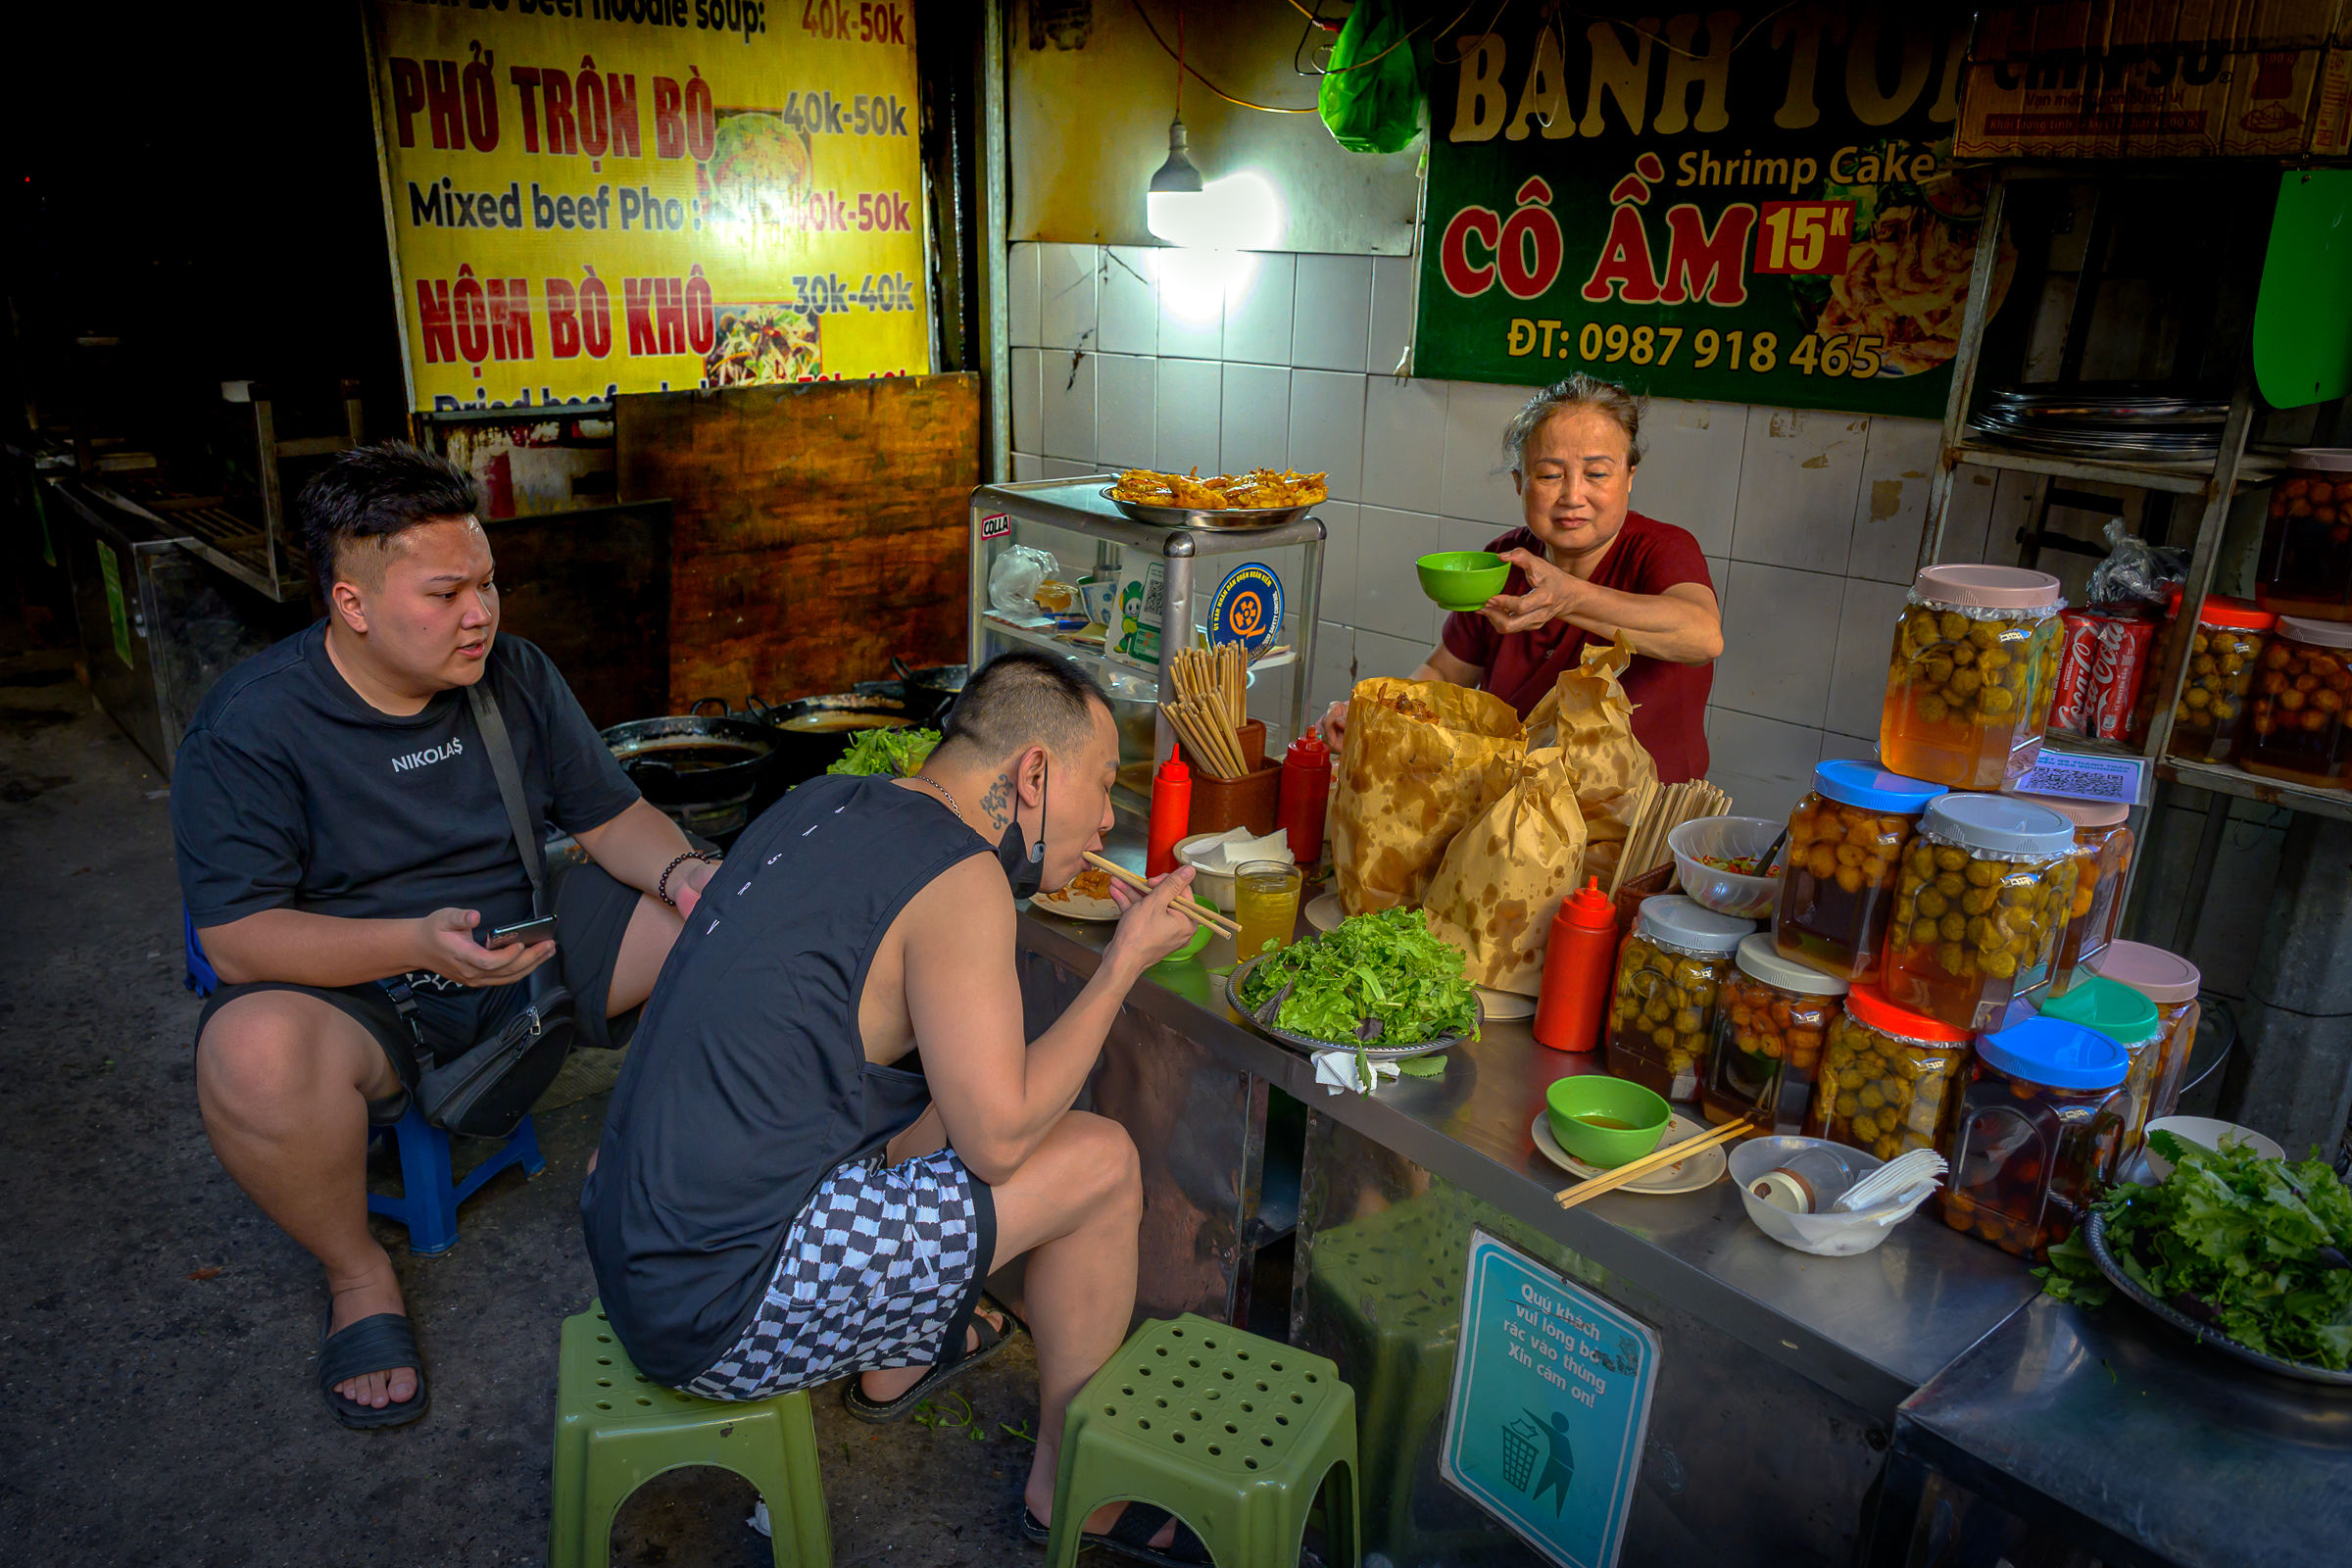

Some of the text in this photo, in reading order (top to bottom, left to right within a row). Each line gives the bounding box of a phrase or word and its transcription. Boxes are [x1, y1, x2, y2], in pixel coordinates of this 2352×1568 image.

[695, 0, 765, 44] soup:
[802, 0, 905, 45] 40k-50k
[389, 39, 716, 172] PHỞ TRỘN BÒ
[784, 90, 909, 137] 40k-50k
[1676, 145, 1936, 195] Shrimp Cake
[408, 175, 523, 228] Mixed
[531, 182, 610, 230] beef
[1440, 174, 1564, 300] CÔ
[791, 273, 914, 315] 30k-40k
[416, 263, 716, 378] NỘM BÒ KHÔ
[1506, 318, 1885, 379] ĐT: 0987 918 465
[983, 515, 1008, 535] COLLA
[1516, 1303, 1539, 1327] vui
[1543, 1317, 1576, 1352] lòng
[1521, 1284, 1600, 1342] Quý khách
[1503, 1320, 1606, 1396] rác vào thùng
[1508, 1342, 1533, 1369] Xin
